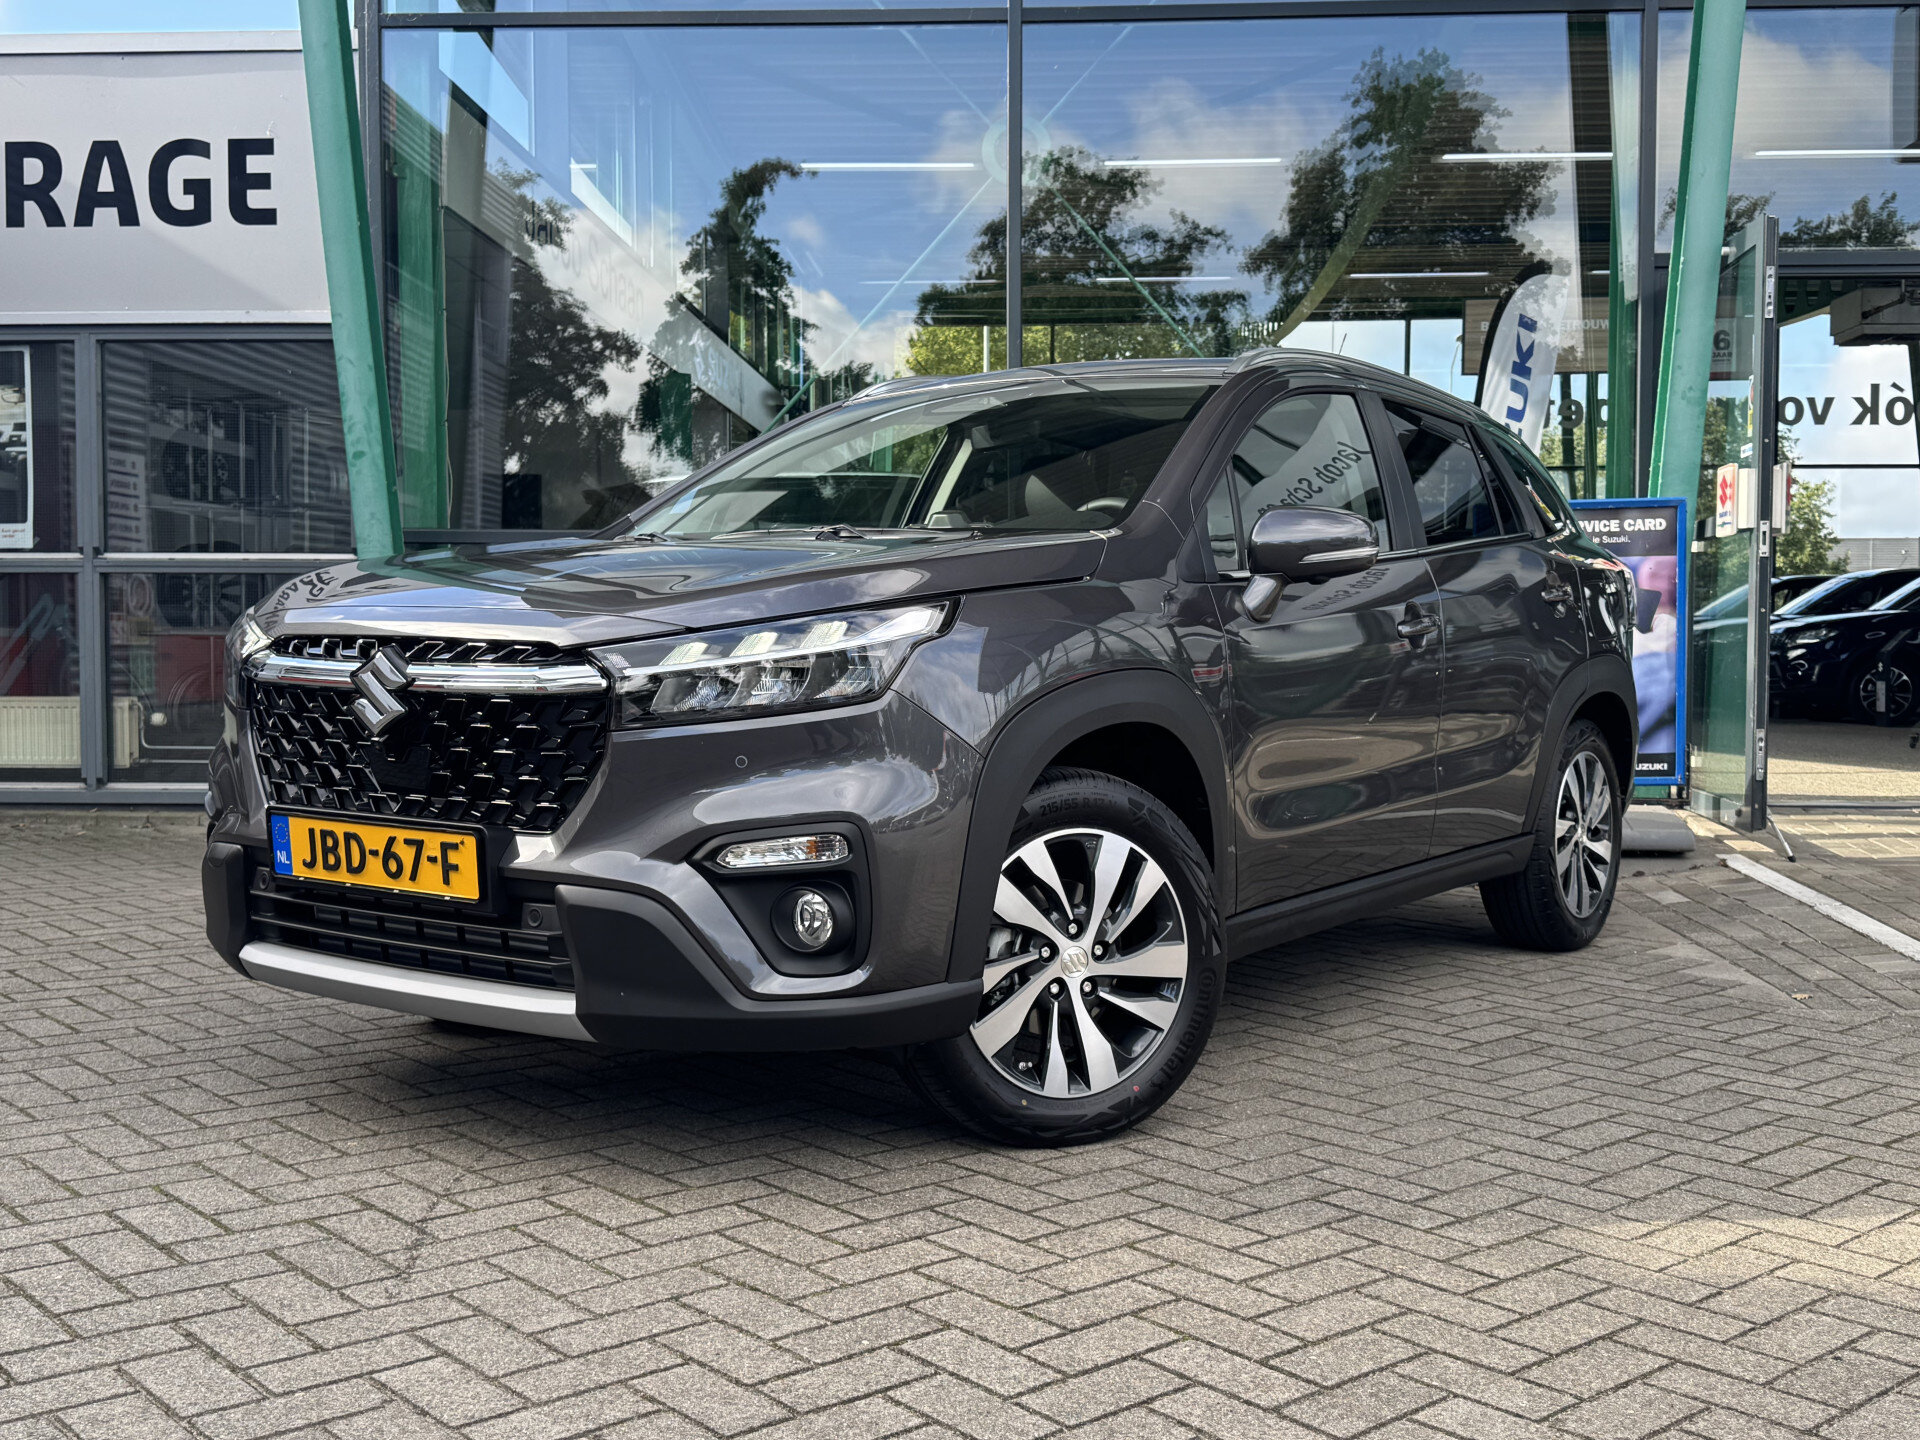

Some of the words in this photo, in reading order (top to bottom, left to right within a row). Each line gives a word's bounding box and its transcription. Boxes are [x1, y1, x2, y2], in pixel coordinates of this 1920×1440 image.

[5, 138, 278, 228] RAGE
[1623, 518, 1668, 532] CARD
[1040, 798, 1079, 817] 215/55
[276, 850, 291, 865] NL
[302, 827, 460, 887] JBD-67-F
